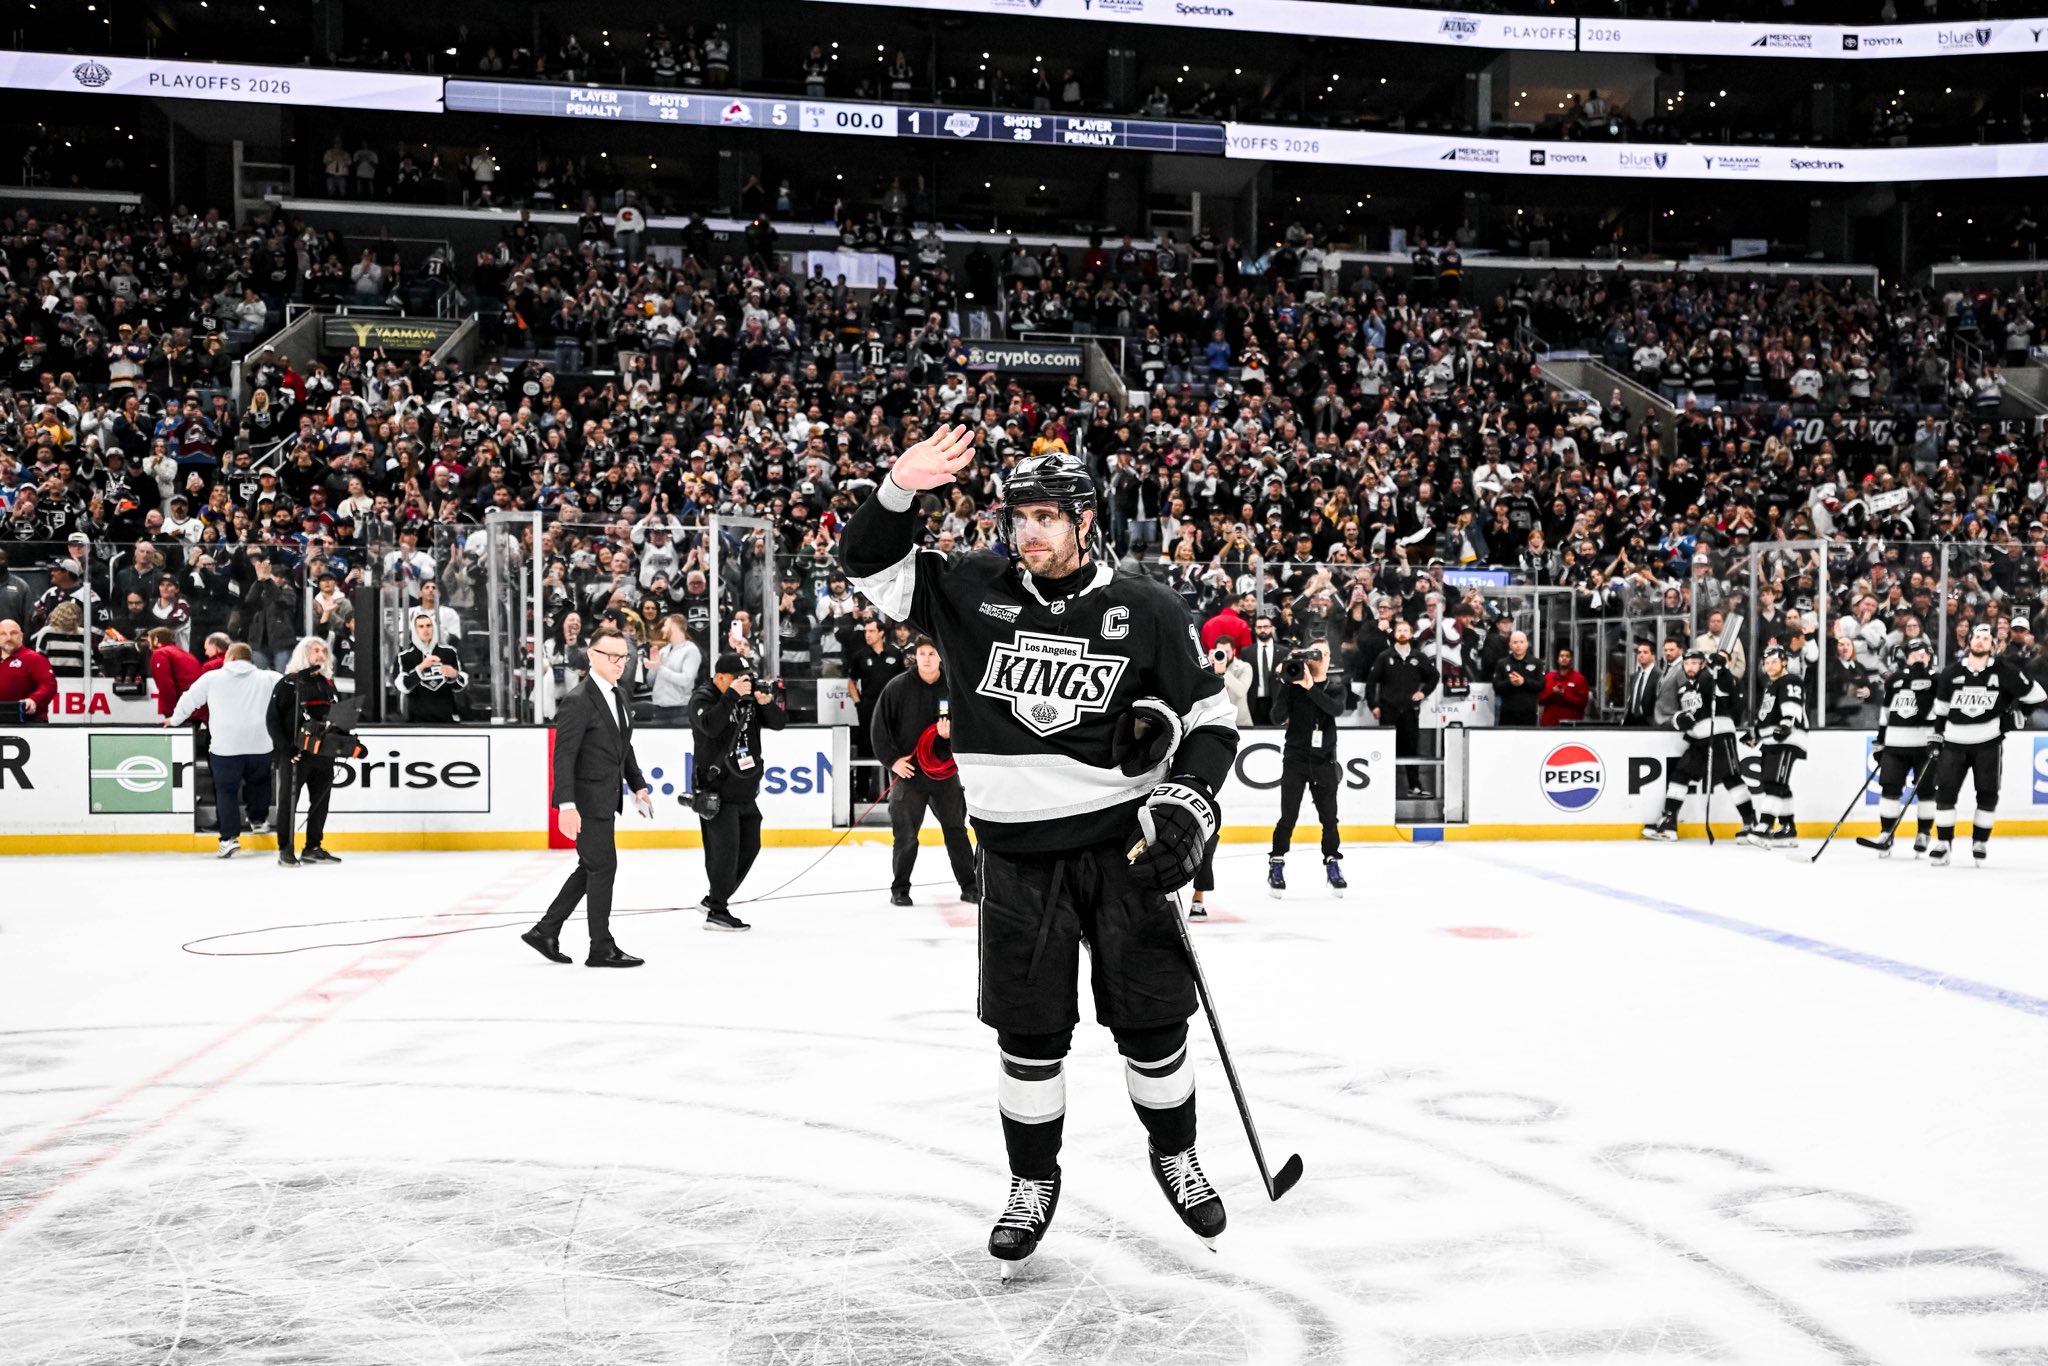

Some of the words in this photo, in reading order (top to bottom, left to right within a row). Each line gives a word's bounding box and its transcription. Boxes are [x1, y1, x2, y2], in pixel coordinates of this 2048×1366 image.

[1176, 2, 1231, 17] Spectrum
[1442, 20, 1478, 34] KINGS
[1503, 26, 1577, 40] PLAYOFFS
[1587, 29, 1621, 42] 2026
[1769, 34, 1812, 42] MERCURY
[1863, 37, 1903, 46] TOYOTA
[1937, 31, 1974, 45] blue
[149, 72, 241, 91] PLAYOFFS
[248, 79, 291, 94] 2026
[570, 89, 617, 104] PLAYER
[648, 94, 689, 108] SHOTS
[566, 102, 622, 118] PENALTY
[659, 107, 679, 120] 32
[771, 104, 788, 126] 5
[805, 106, 825, 117] PER
[812, 117, 820, 128] 3
[836, 111, 884, 129] 00.0
[907, 111, 920, 134] 1
[1003, 115, 1042, 129] SHOTS
[1068, 119, 1112, 132] PLAYER
[1013, 128, 1032, 140] 25
[1064, 132, 1117, 145] PENALTY
[1285, 139, 1319, 153] 2026
[1458, 148, 1500, 156] MERCURY
[1550, 154, 1587, 163] TOYOTA
[1619, 152, 1652, 166] blue
[1790, 158, 1841, 170] Spectrum
[428, 262, 441, 276] 21
[870, 347, 884, 365] 11
[985, 349, 1081, 367] crypto.com
[979, 607, 1016, 624] INSURANCE
[981, 602, 1017, 620] MERCURY
[1100, 605, 1130, 640] C
[1025, 643, 1039, 653] Los
[1041, 644, 1077, 657] Angeles
[992, 654, 1113, 702] KINGS
[1988, 674, 2000, 688] A
[1786, 684, 1802, 699] 12
[1955, 694, 1994, 707] KINGS
[1545, 770, 1601, 784] PEPSI
